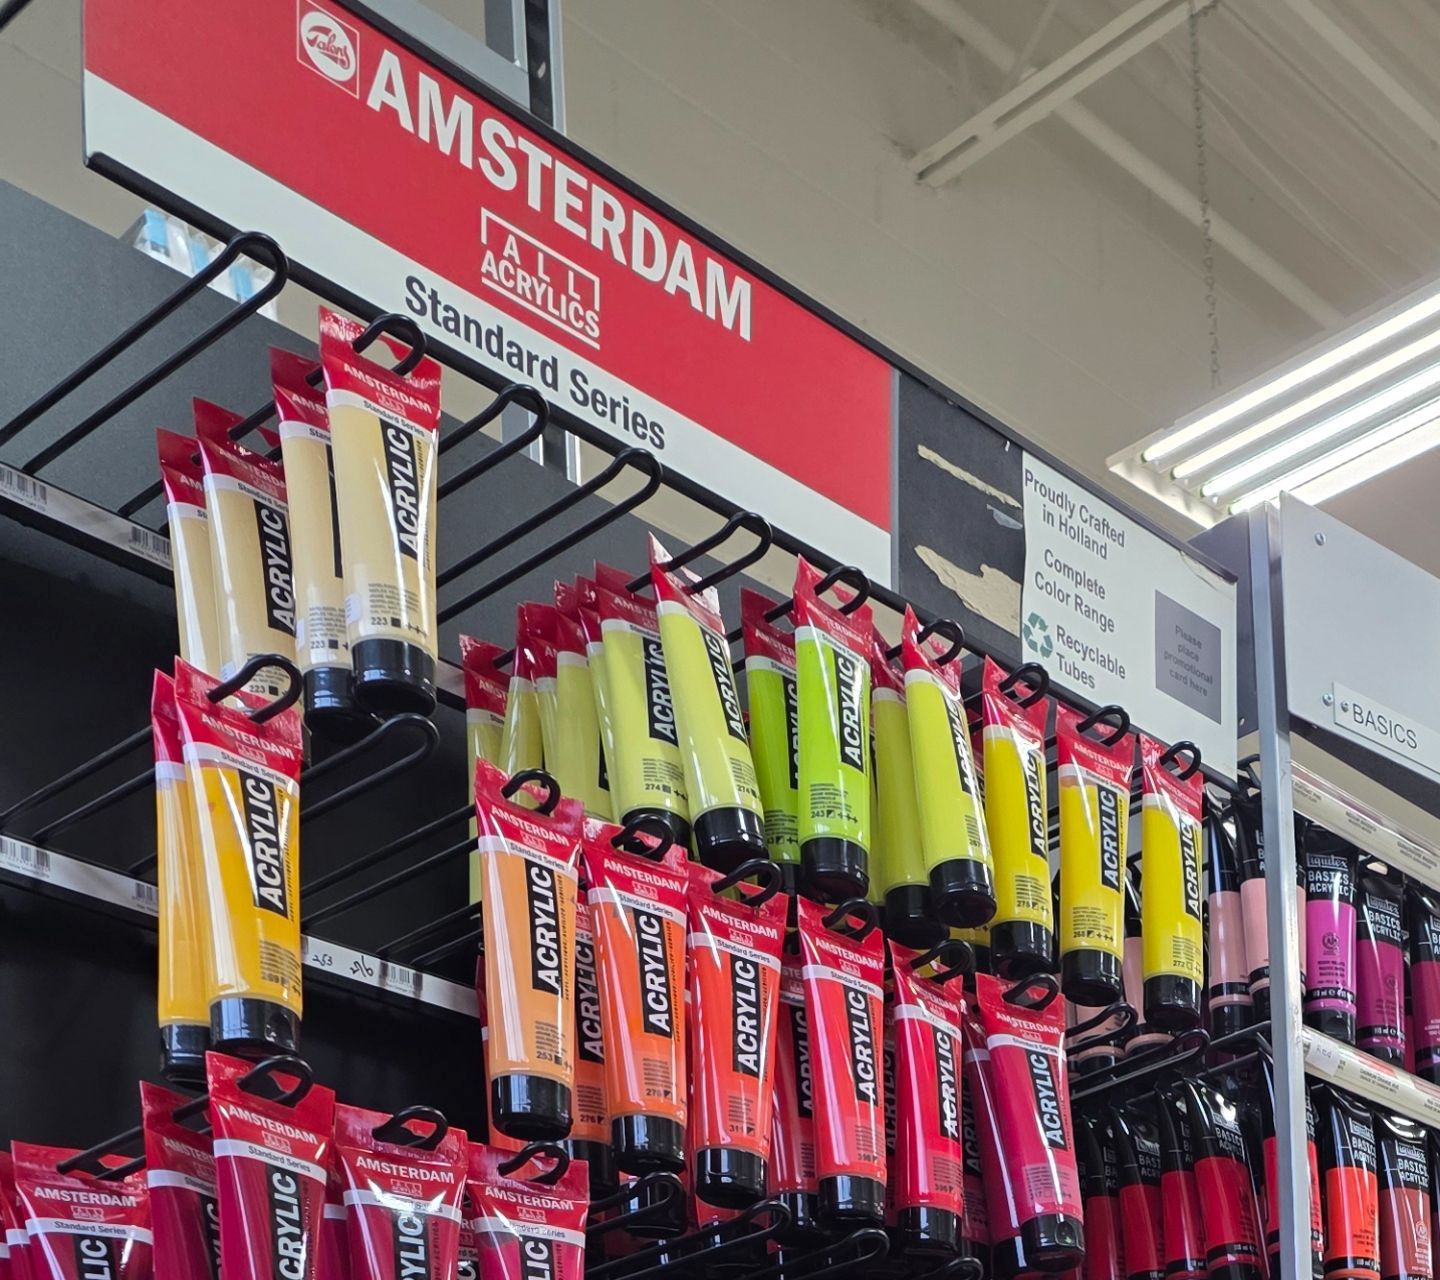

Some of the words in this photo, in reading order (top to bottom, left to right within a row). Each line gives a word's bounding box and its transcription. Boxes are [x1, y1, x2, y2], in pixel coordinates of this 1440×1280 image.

[366, 49, 752, 343] AMSTERDAM
[480, 250, 600, 339] ACRYLICS
[502, 234, 581, 298] ALL
[403, 274, 559, 393] Standard
[569, 368, 666, 451] Series
[387, 427, 419, 554] ACRYLIC
[1025, 468, 1076, 519] Proudly
[1079, 504, 1125, 548] Crafted
[1042, 504, 1055, 527] in
[1058, 513, 1107, 560] Holland
[1034, 571, 1071, 606] Color
[1074, 593, 1115, 633] Range
[1044, 549, 1106, 600] Complete
[1056, 625, 1126, 680] Recyclable
[1056, 652, 1096, 689] Tubes
[1169, 668, 1189, 687] card
[1190, 678, 1208, 697] here
[200, 713, 294, 760] AMSTERDAM
[1353, 702, 1418, 750] BASICS
[246, 778, 284, 912] ACRYLIC
[490, 804, 570, 848] AMSTERDAM
[530, 865, 561, 990] ACRYLIC
[637, 914, 671, 1033] ACRYLIC
[226, 1104, 318, 1145] AMSTERDAM
[356, 1154, 455, 1185] AMSTERDAM
